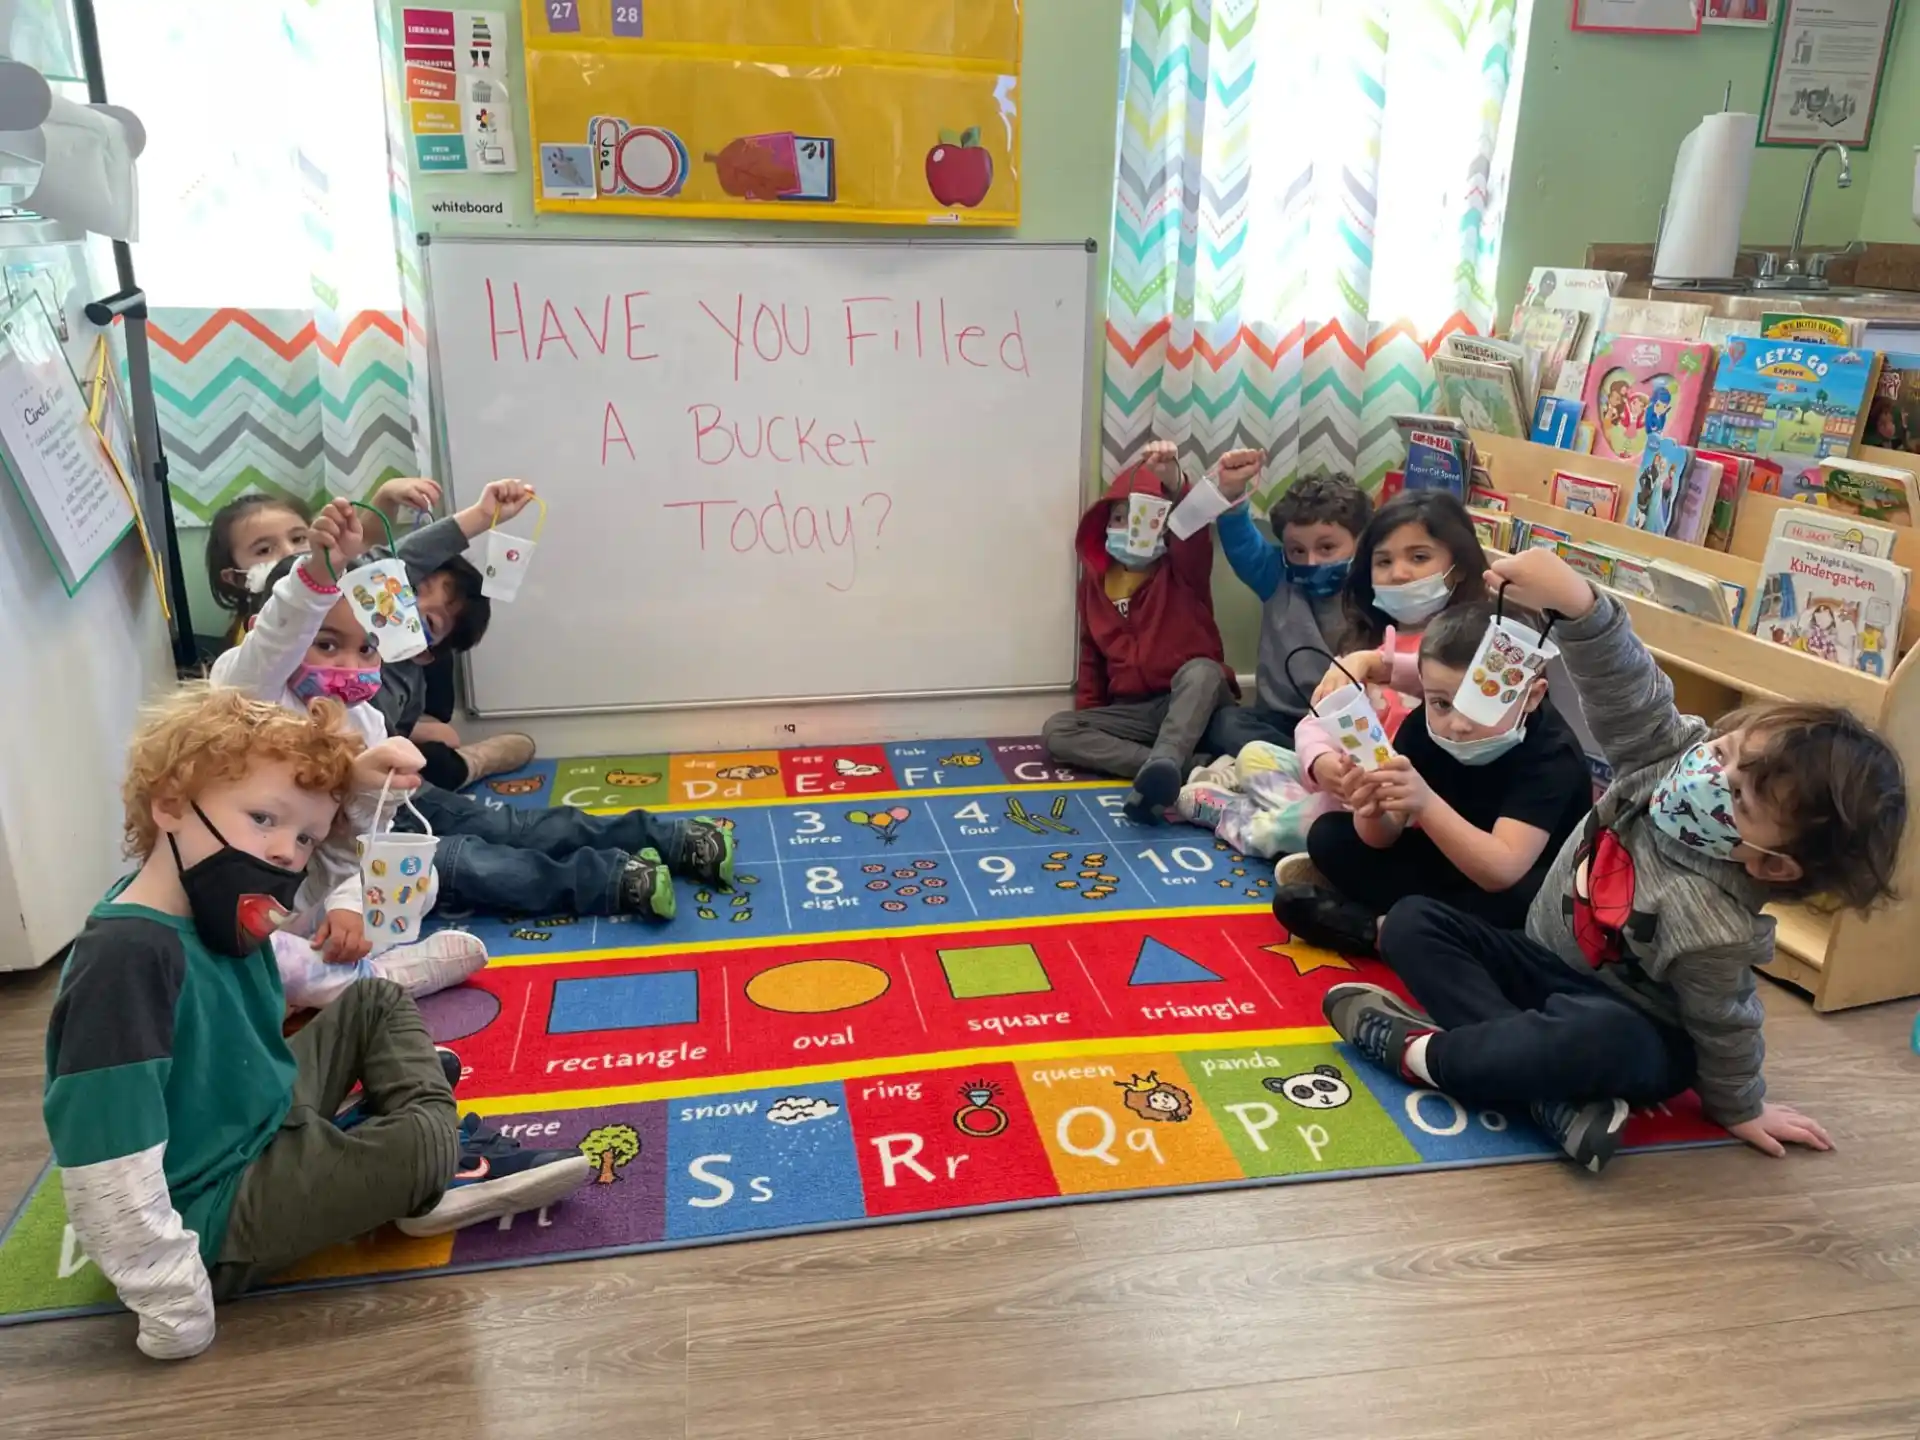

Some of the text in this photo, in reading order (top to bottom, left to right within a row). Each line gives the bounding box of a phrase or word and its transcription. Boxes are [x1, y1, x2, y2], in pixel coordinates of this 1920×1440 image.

[551, 2, 573, 19] 27
[616, 7, 638, 23] 28
[431, 201, 504, 214] whiteboard
[486, 277, 1031, 382] HAVE YOU Filled
[1754, 347, 1830, 377] LET'S GO
[1772, 366, 1805, 378] Explore
[601, 401, 637, 466] A
[662, 489, 894, 593] Today?
[1805, 551, 1819, 562] The
[1820, 555, 1841, 568] Night
[1789, 556, 1876, 592] Kindergarten
[792, 755, 825, 765] egg
[894, 747, 927, 757] fish
[569, 765, 596, 775] cat
[683, 759, 718, 770] dog
[793, 811, 826, 834] 3
[953, 800, 990, 825] 4
[788, 833, 843, 846] three
[959, 824, 1001, 836] four
[977, 855, 1016, 883] 9
[1136, 846, 1214, 874] 10
[805, 866, 844, 895] 8
[988, 884, 1035, 897] nine
[1160, 875, 1197, 886] ten
[802, 896, 861, 912] eight
[1140, 996, 1258, 1024] triangle
[966, 1008, 1072, 1036] square
[792, 1024, 855, 1051] oval
[545, 1041, 709, 1075] rectangle
[1200, 1050, 1282, 1078] panda
[1031, 1062, 1117, 1089] queen
[861, 1080, 924, 1103] ring
[679, 1100, 760, 1123] snow
[499, 1119, 562, 1139] tree
